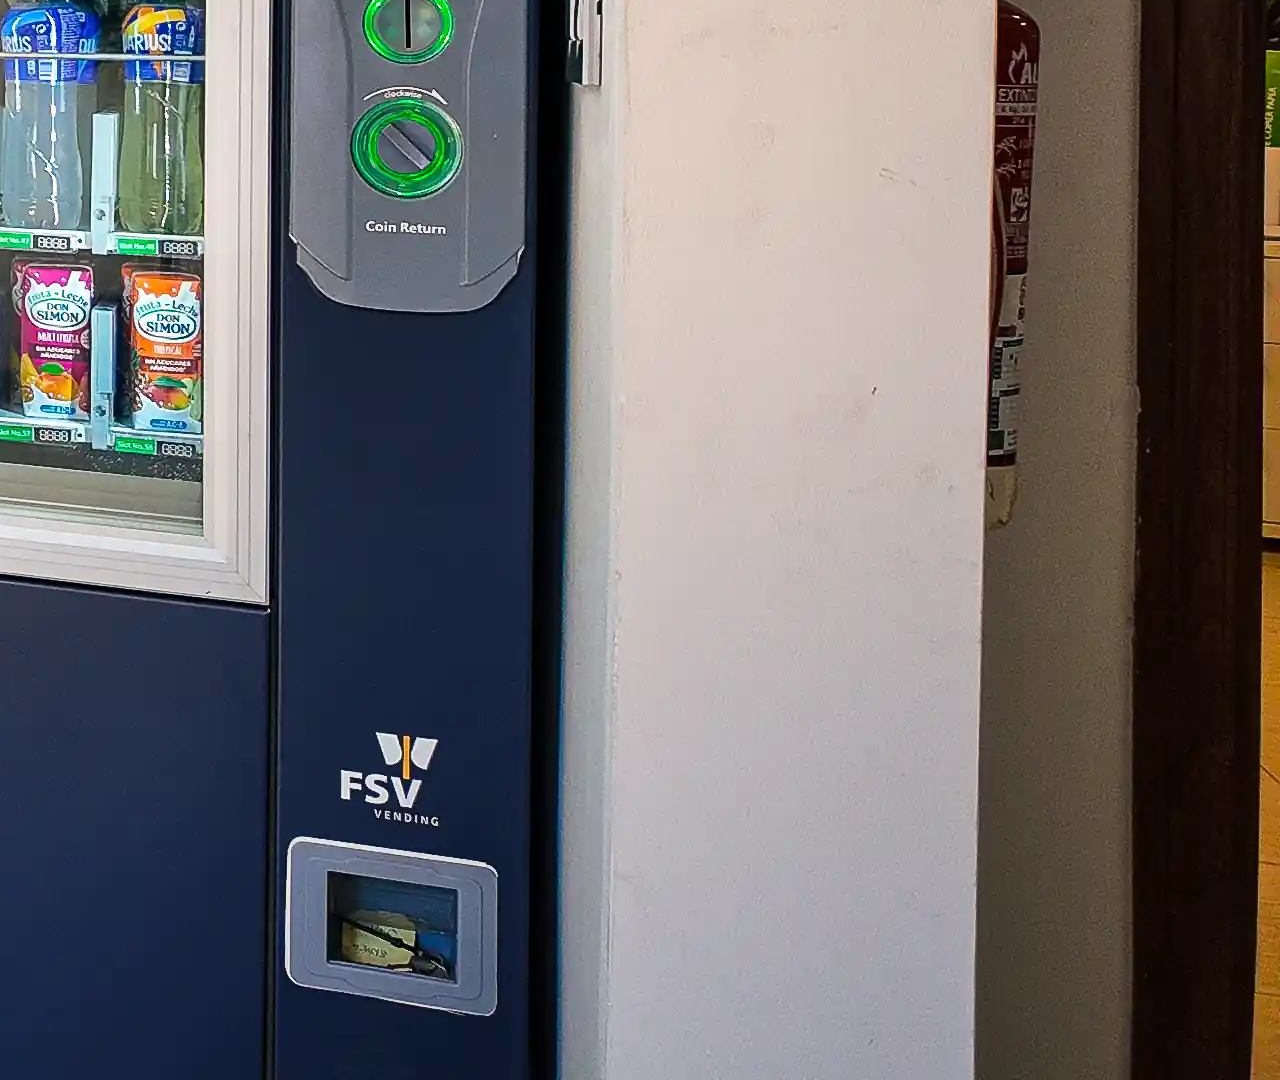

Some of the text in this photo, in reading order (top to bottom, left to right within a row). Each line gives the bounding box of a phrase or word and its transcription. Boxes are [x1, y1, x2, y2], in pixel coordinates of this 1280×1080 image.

[384, 90, 422, 100] clockwise
[365, 220, 446, 235] Coin Return
[47, 303, 68, 311] DON
[37, 311, 79, 322] SIMON
[157, 314, 180, 322] DON
[146, 322, 190, 335] SIMON
[341, 770, 422, 808] FSV
[374, 809, 440, 827] VENDING
